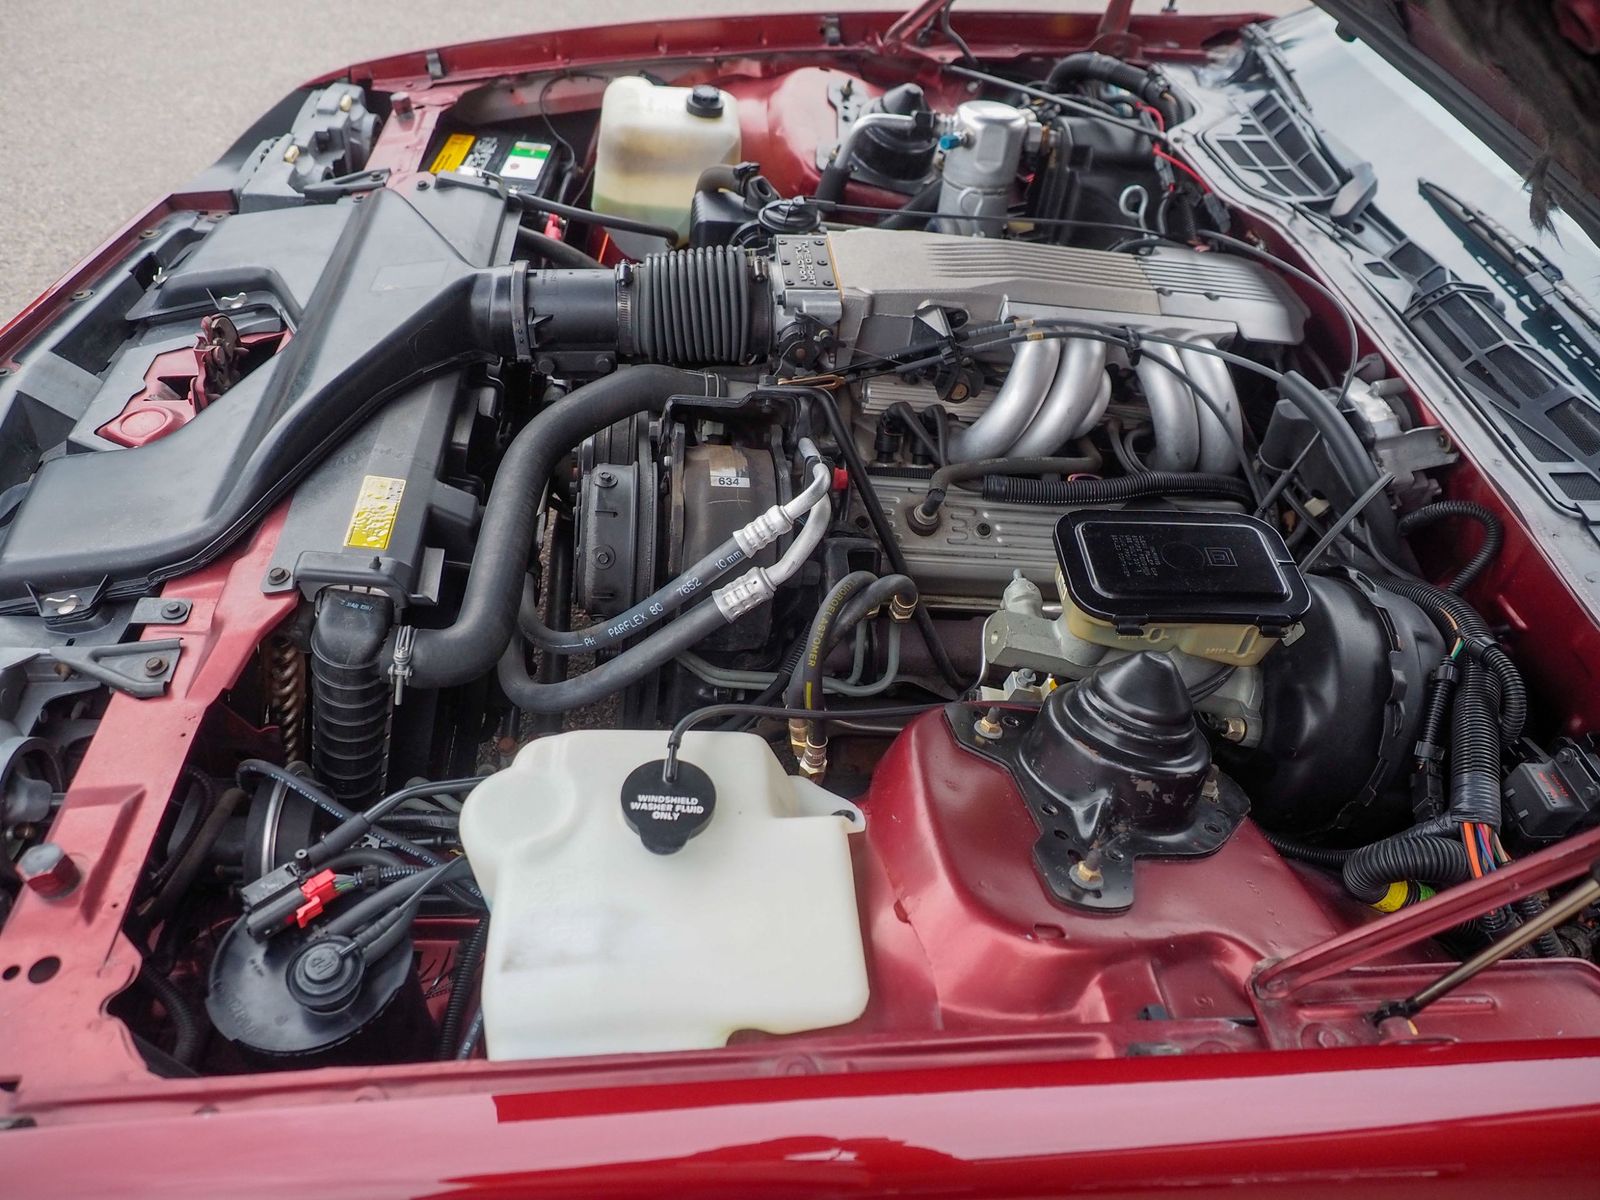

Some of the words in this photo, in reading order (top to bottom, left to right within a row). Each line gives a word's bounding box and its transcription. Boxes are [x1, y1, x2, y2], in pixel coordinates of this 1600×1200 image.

[795, 245, 808, 281] NJECTION
[718, 476, 740, 486] 634
[583, 636, 597, 647] PH
[607, 611, 649, 638] PARFLEX
[649, 602, 665, 616] 80
[676, 576, 703, 597] 7652
[714, 559, 728, 571] 10
[727, 550, 744, 563] mm
[637, 794, 699, 806] WINDSHIELD
[630, 802, 673, 812] WASHER
[674, 804, 704, 815] FLUID
[651, 811, 681, 821] ONLY
